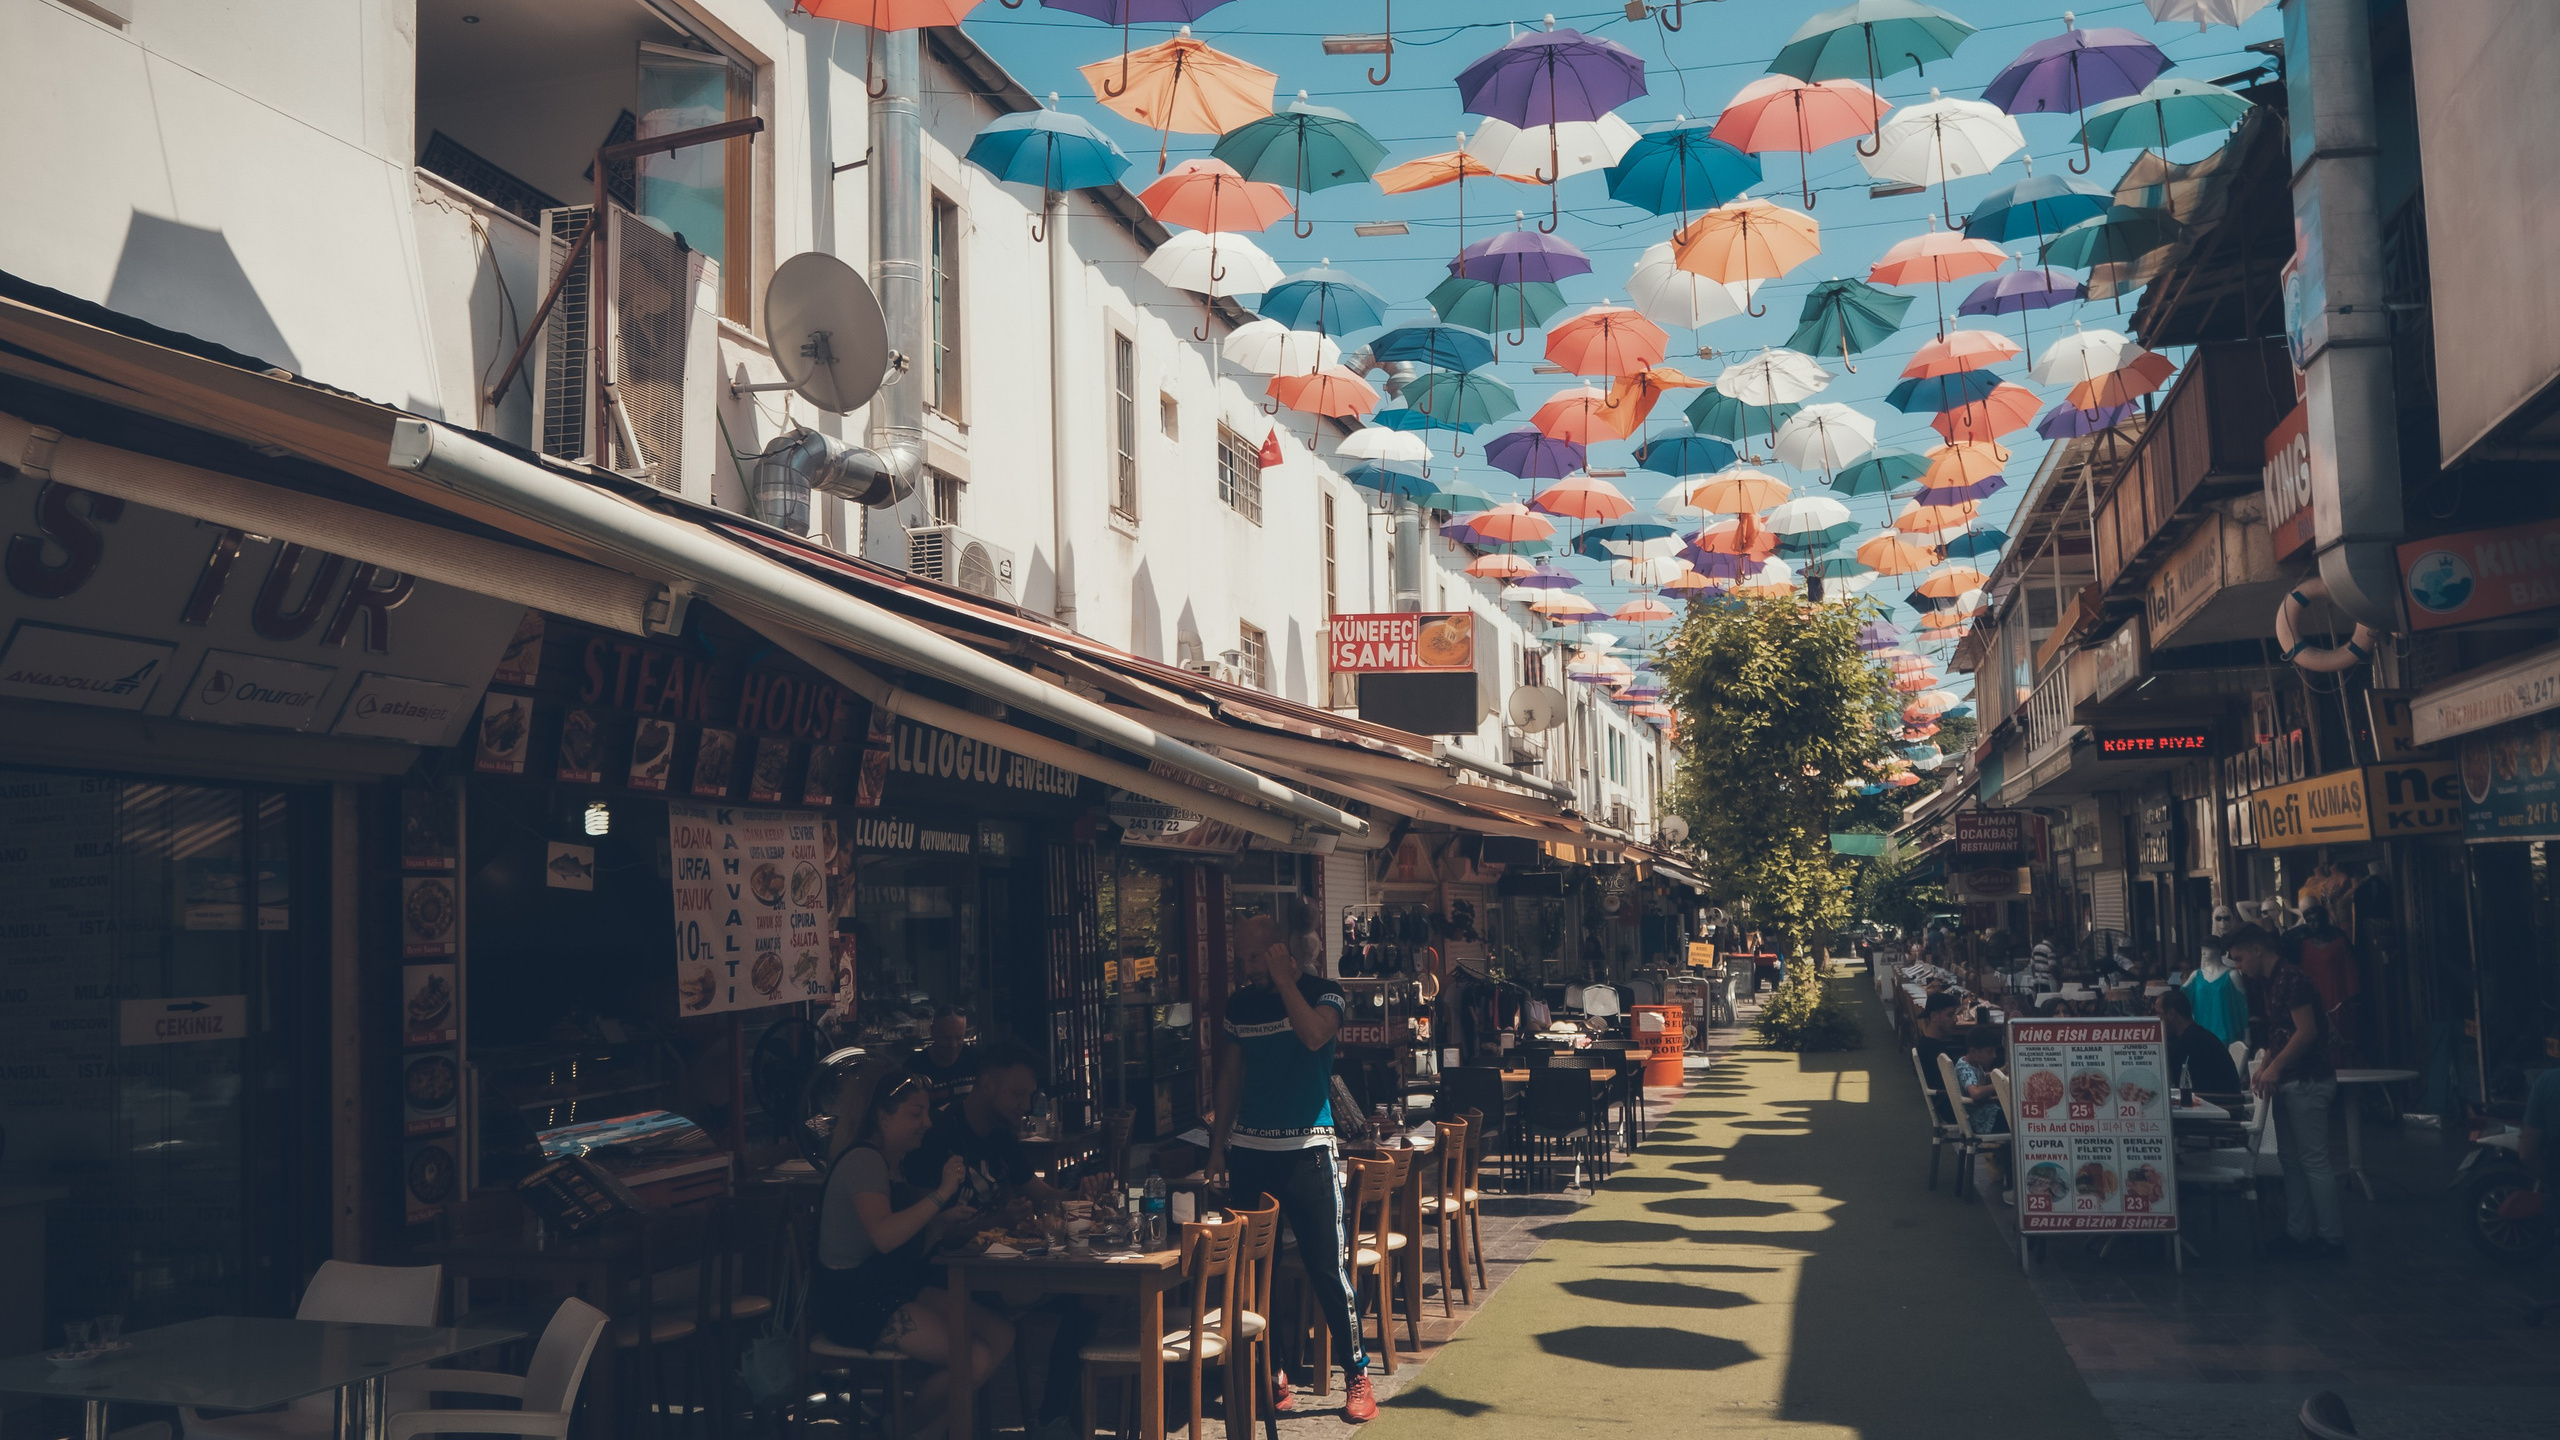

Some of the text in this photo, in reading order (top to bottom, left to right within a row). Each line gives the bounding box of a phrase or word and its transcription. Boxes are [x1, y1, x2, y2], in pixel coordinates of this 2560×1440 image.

[2263, 433, 2312, 534] KING
[182, 518, 415, 654] TUR
[1332, 615, 1417, 642] KÜNEFECİ
[1340, 643, 1408, 668] SAMİ
[5, 670, 140, 696] ANADOLUJET
[580, 636, 849, 742] STEAK HOUSE
[2534, 676, 2555, 704] 247
[236, 682, 314, 708] Onurair
[380, 699, 448, 721] atlasjet
[2104, 736, 2205, 751] KÖFTE PİYAZ
[1006, 755, 1079, 798] JEWELLERY
[2257, 780, 2362, 839] nefi KUMAŞ
[2527, 803, 2547, 825] 247
[1130, 818, 1179, 831] 243 12 22
[1960, 827, 2018, 841] OCAKBAŞI
[920, 829, 971, 855] KUYUMCULUK
[1961, 841, 2018, 852] RESTAURANT
[678, 858, 711, 881] URFA
[676, 888, 713, 911] TAVUK
[807, 980, 827, 995] 30TL
[155, 1015, 223, 1039] ÇEKİNİZ
[1239, 1021, 1285, 1034] INTERNATIONAL
[2019, 1025, 2156, 1042] KİNG FİSH BALIKEVİ
[2027, 1122, 2095, 1135] Fish And Chips
[2029, 1139, 2064, 1149] ÇUPRA
[2075, 1137, 2114, 1145] MORİNA
[2078, 1145, 2112, 1153] FİLETO
[2126, 1145, 2161, 1153] FİLETO
[2025, 1153, 2068, 1161] KAMPANYA
[2030, 1215, 2169, 1230] BALIK BİZİM İŞİMİZ
